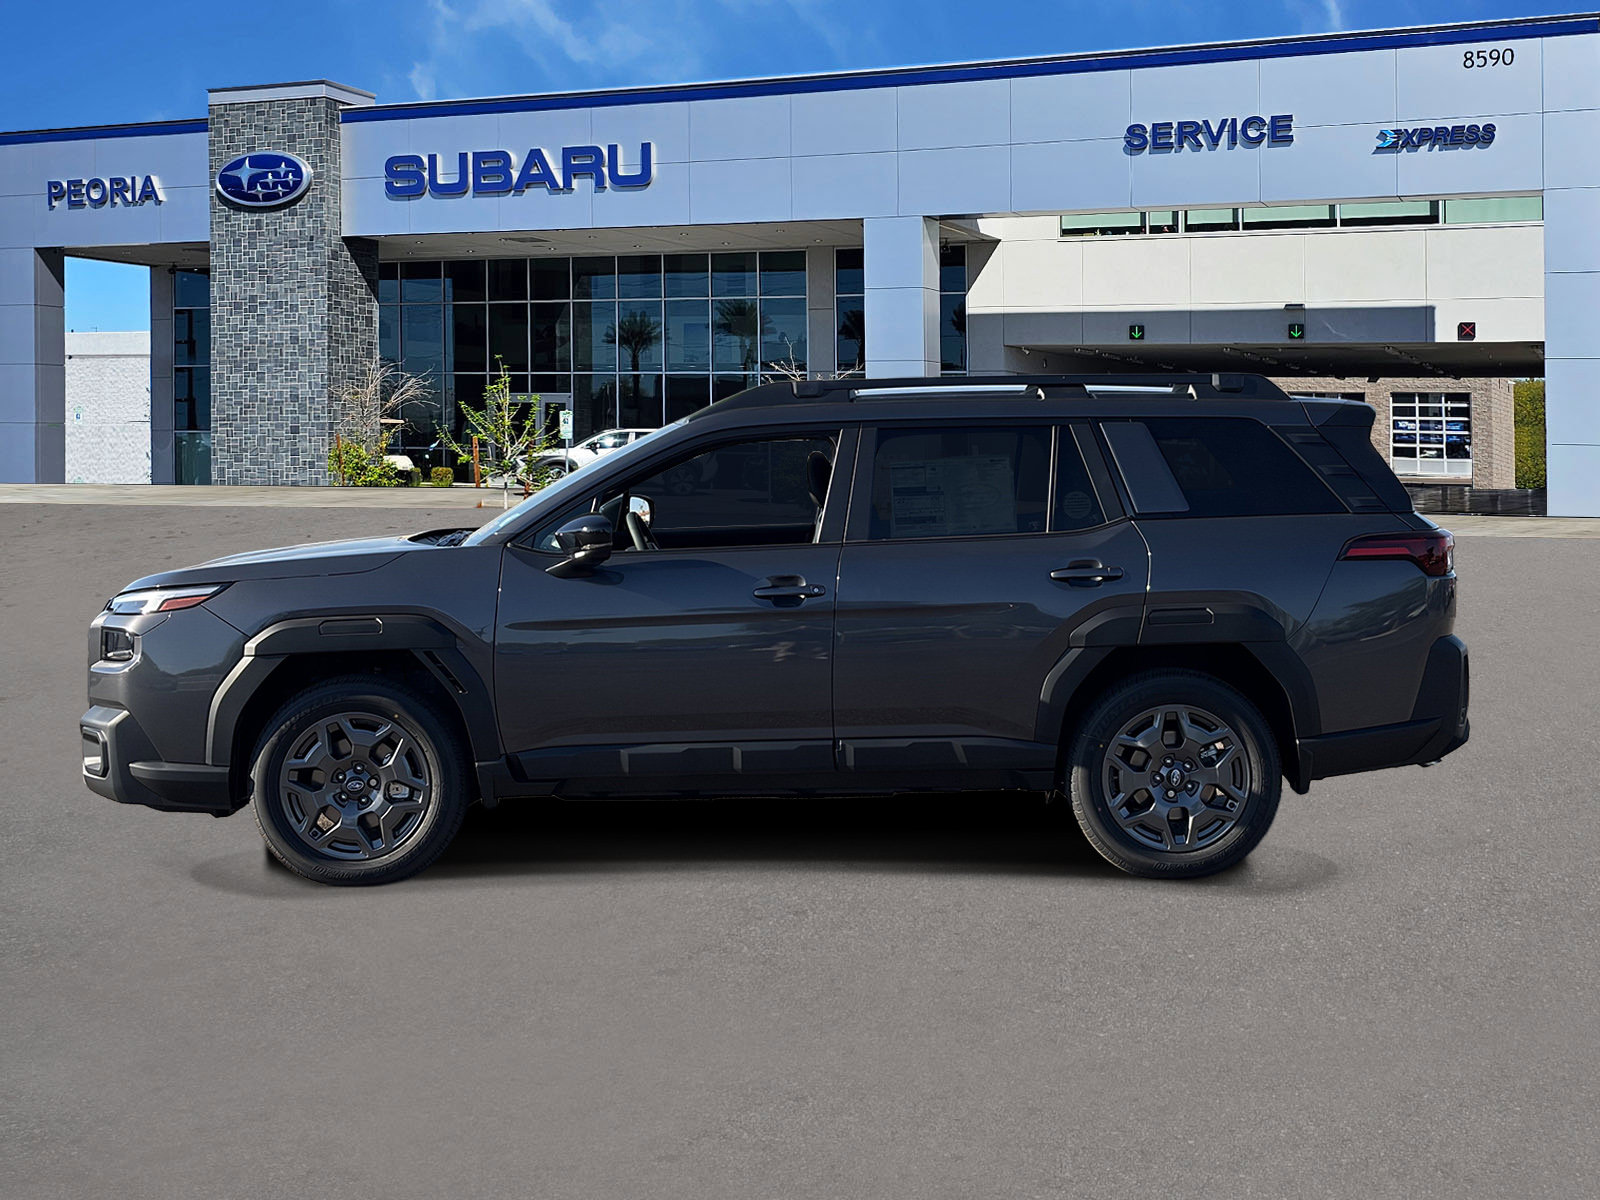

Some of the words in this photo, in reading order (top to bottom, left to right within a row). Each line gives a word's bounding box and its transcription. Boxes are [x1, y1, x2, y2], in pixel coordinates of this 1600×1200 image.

[1463, 48, 1515, 69] 8590
[1125, 114, 1294, 150] SERVICE
[1376, 123, 1497, 147] EXPRESS
[385, 142, 652, 197] SUBARU
[48, 175, 161, 206] PEORIA
